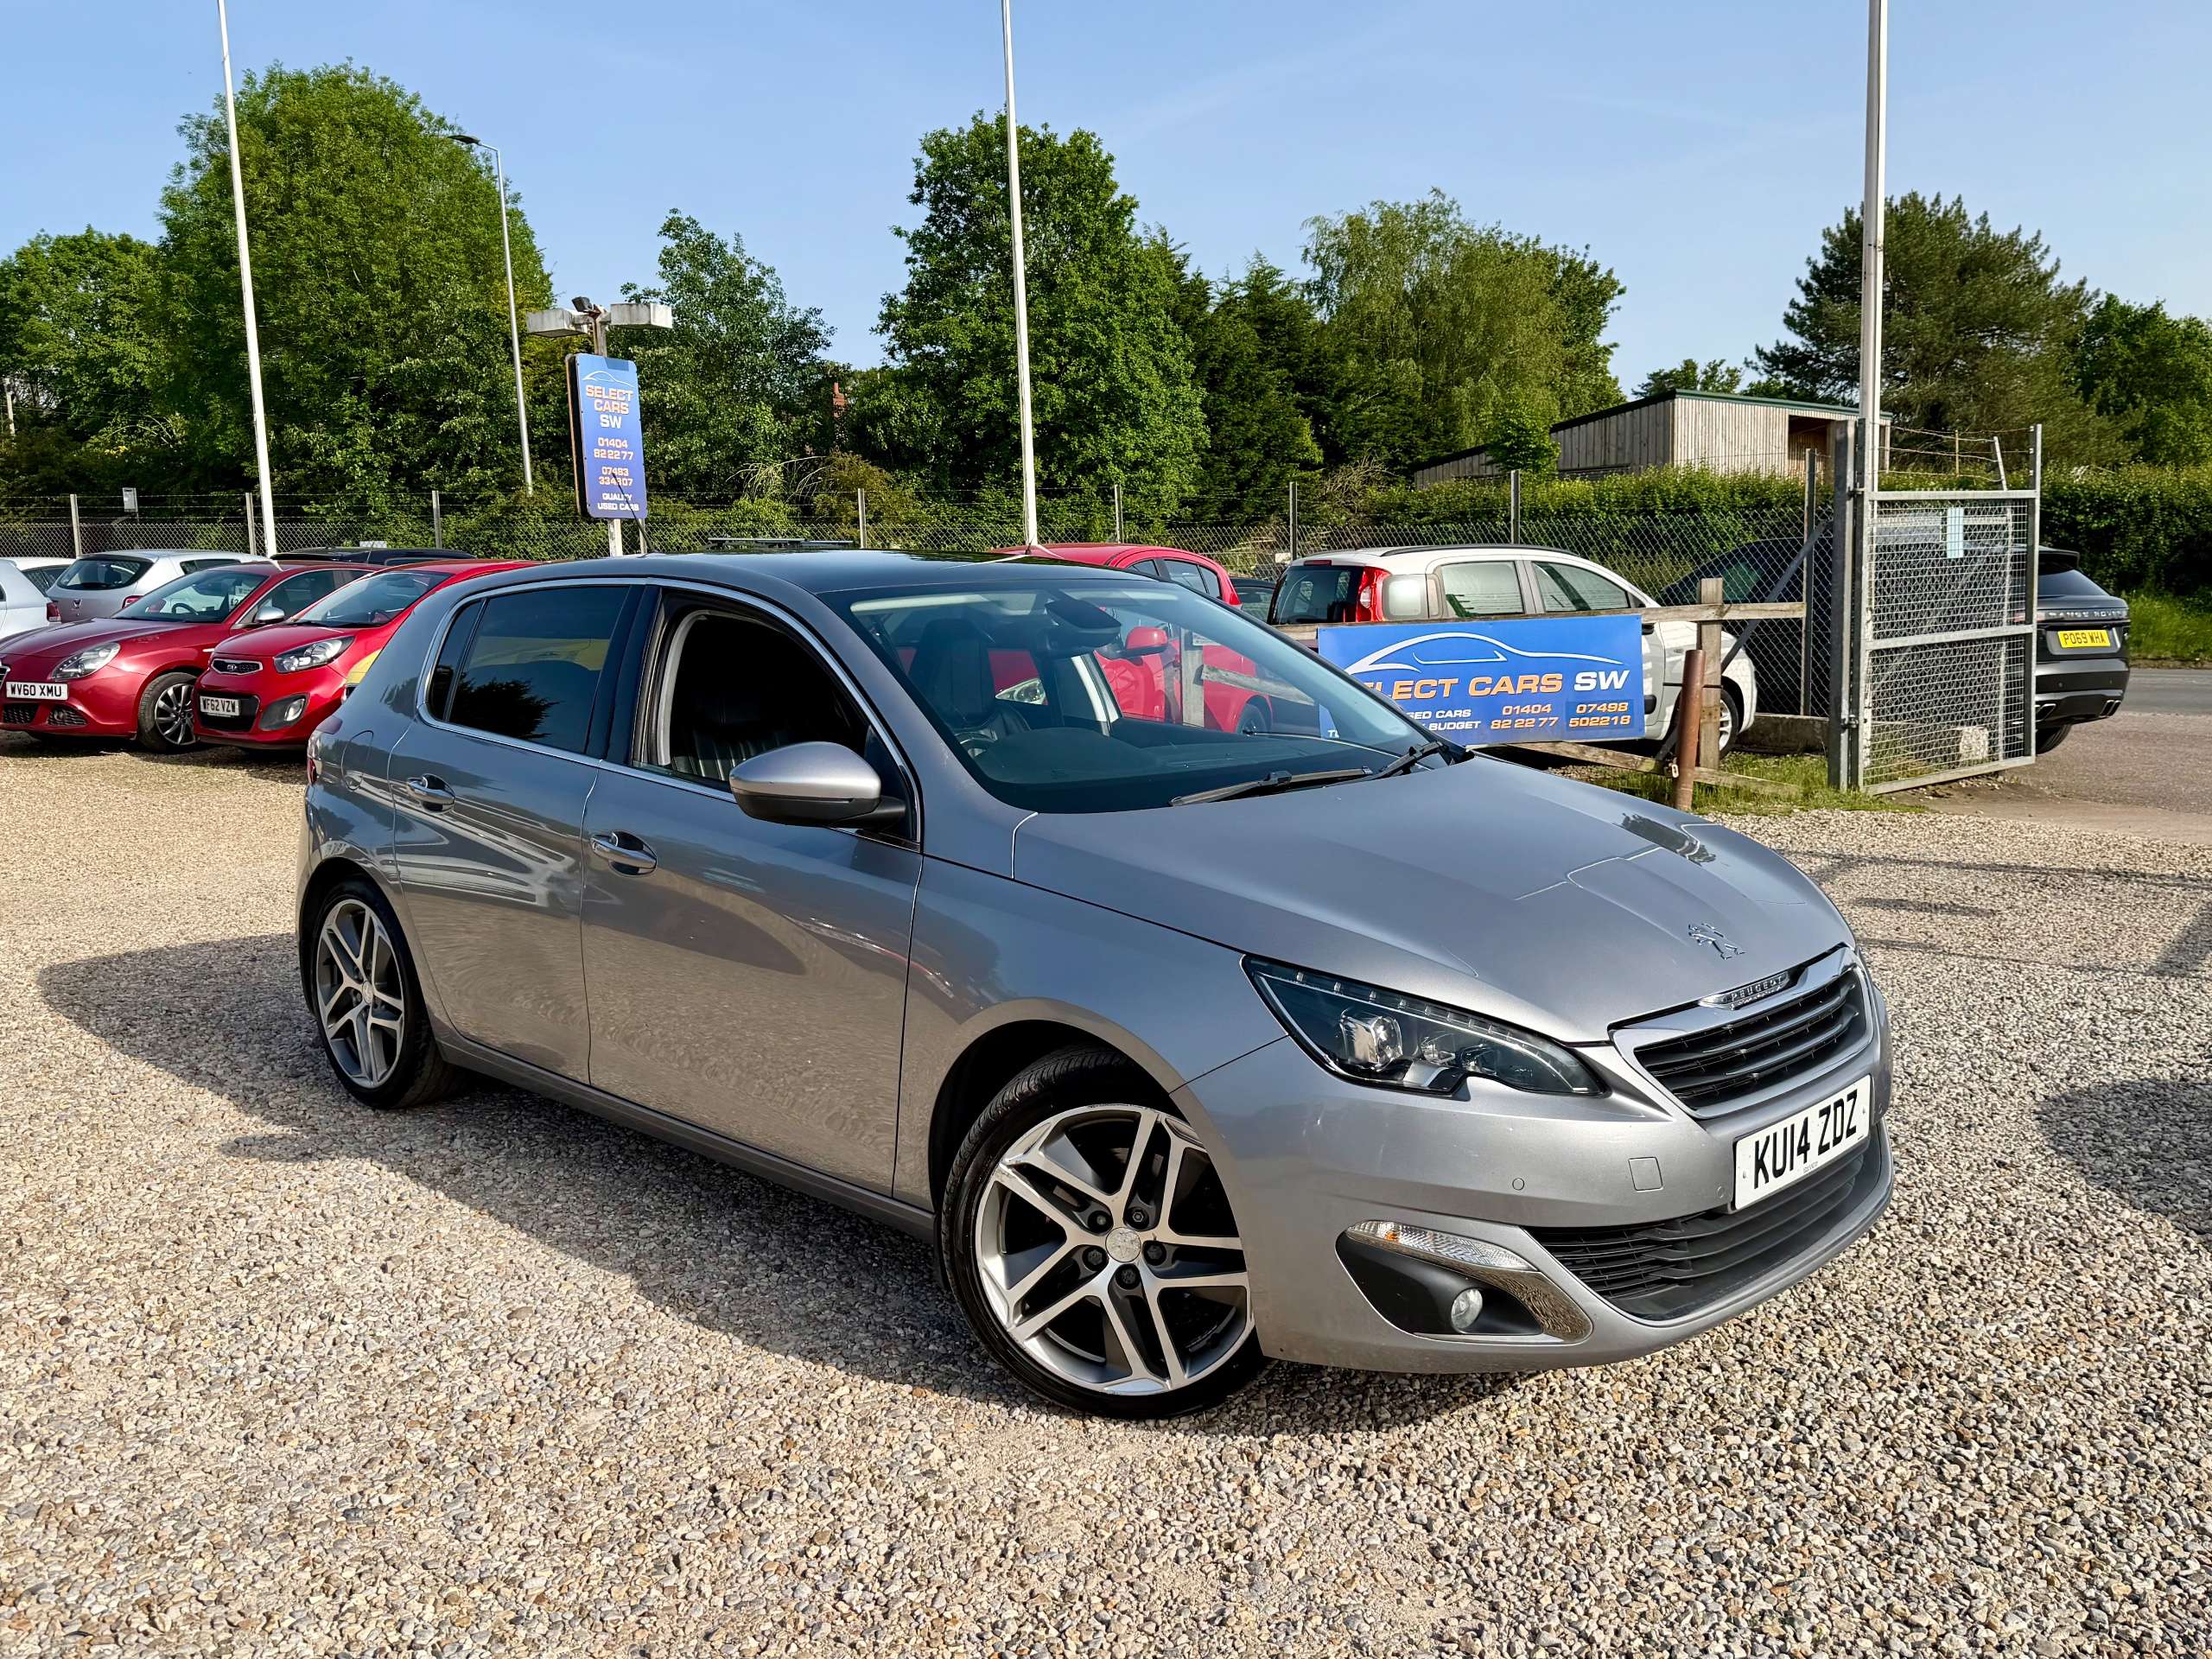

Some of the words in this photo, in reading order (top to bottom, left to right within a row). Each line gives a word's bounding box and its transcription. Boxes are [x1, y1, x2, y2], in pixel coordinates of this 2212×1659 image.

[585, 385, 634, 402] SELECT
[594, 399, 630, 415] CARS
[600, 414, 622, 429] SW
[598, 437, 628, 449] 01404
[620, 503, 639, 512] CARS
[10, 683, 36, 696] WV60
[39, 684, 62, 697] XMU
[1364, 678, 1459, 701] LECT
[1469, 674, 1563, 696] CARS
[1573, 670, 1630, 691] SW
[1435, 709, 1471, 719] CARS
[1503, 704, 1552, 715] 01404
[1576, 702, 1629, 714] 07498
[1428, 721, 1481, 731] BUDGET
[1568, 715, 1631, 728] 502218
[1731, 976, 1783, 1001] PEUGEOT
[1754, 1116, 1811, 1190] KU14
[1817, 1089, 1858, 1156] ZDZ
